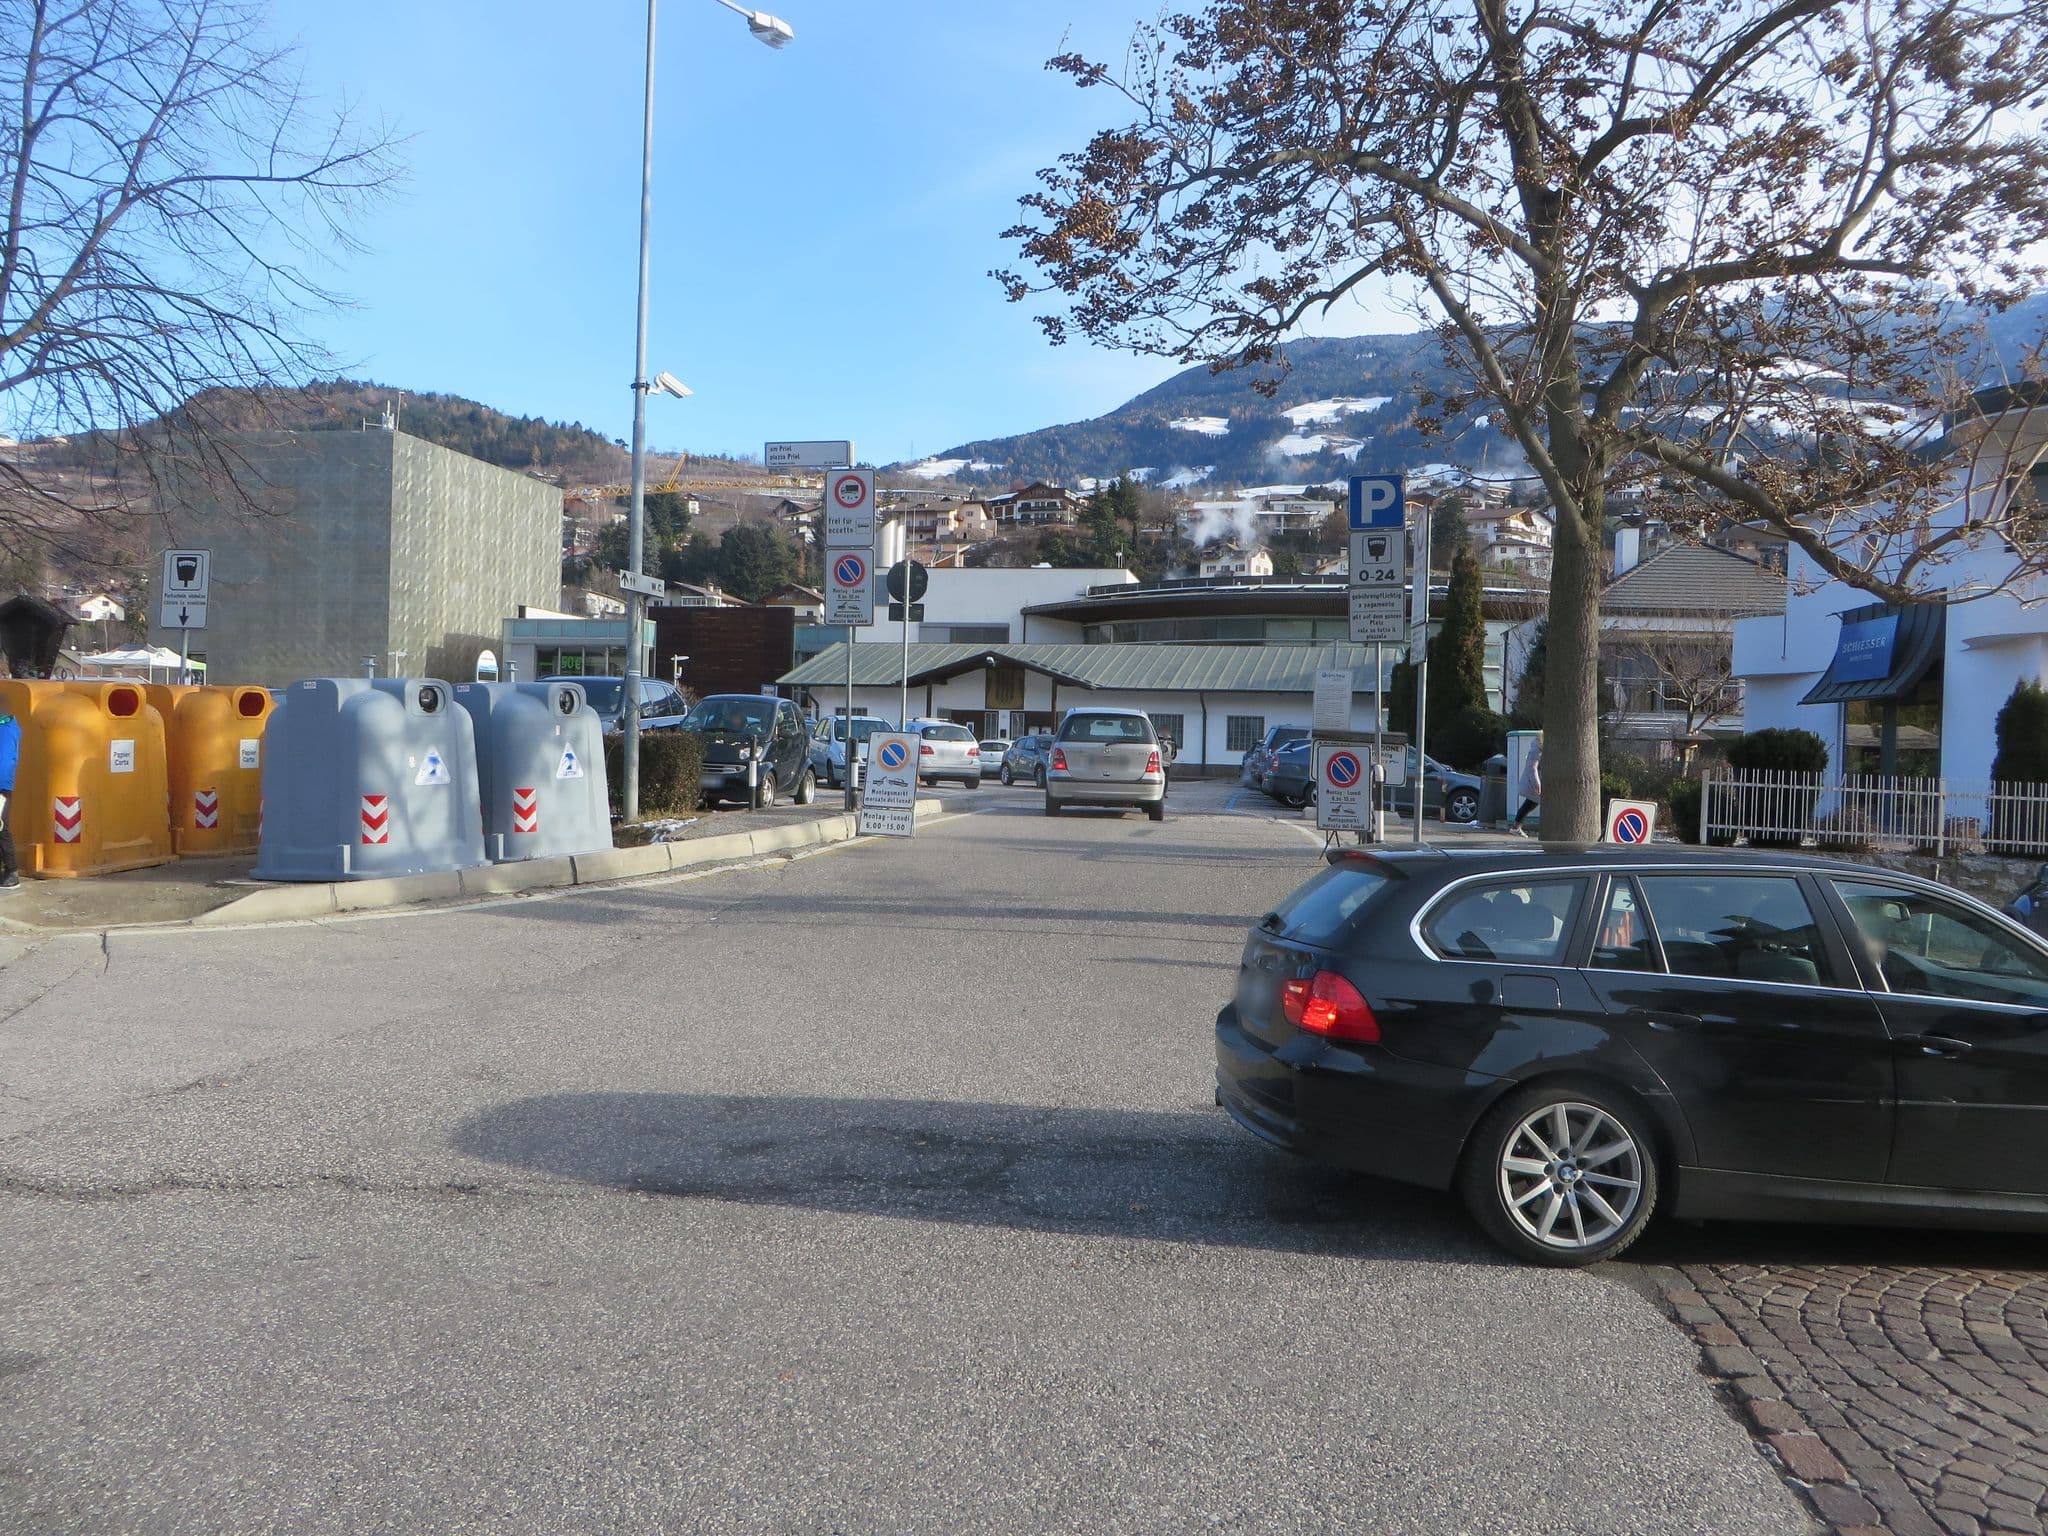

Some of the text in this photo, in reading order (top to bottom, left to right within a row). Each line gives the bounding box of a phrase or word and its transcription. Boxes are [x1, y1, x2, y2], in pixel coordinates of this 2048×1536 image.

[1361, 480, 1396, 524] P
[1359, 569, 1395, 582] 0-24
[1842, 636, 1887, 654] SCHIESSER
[113, 751, 131, 759] Papier
